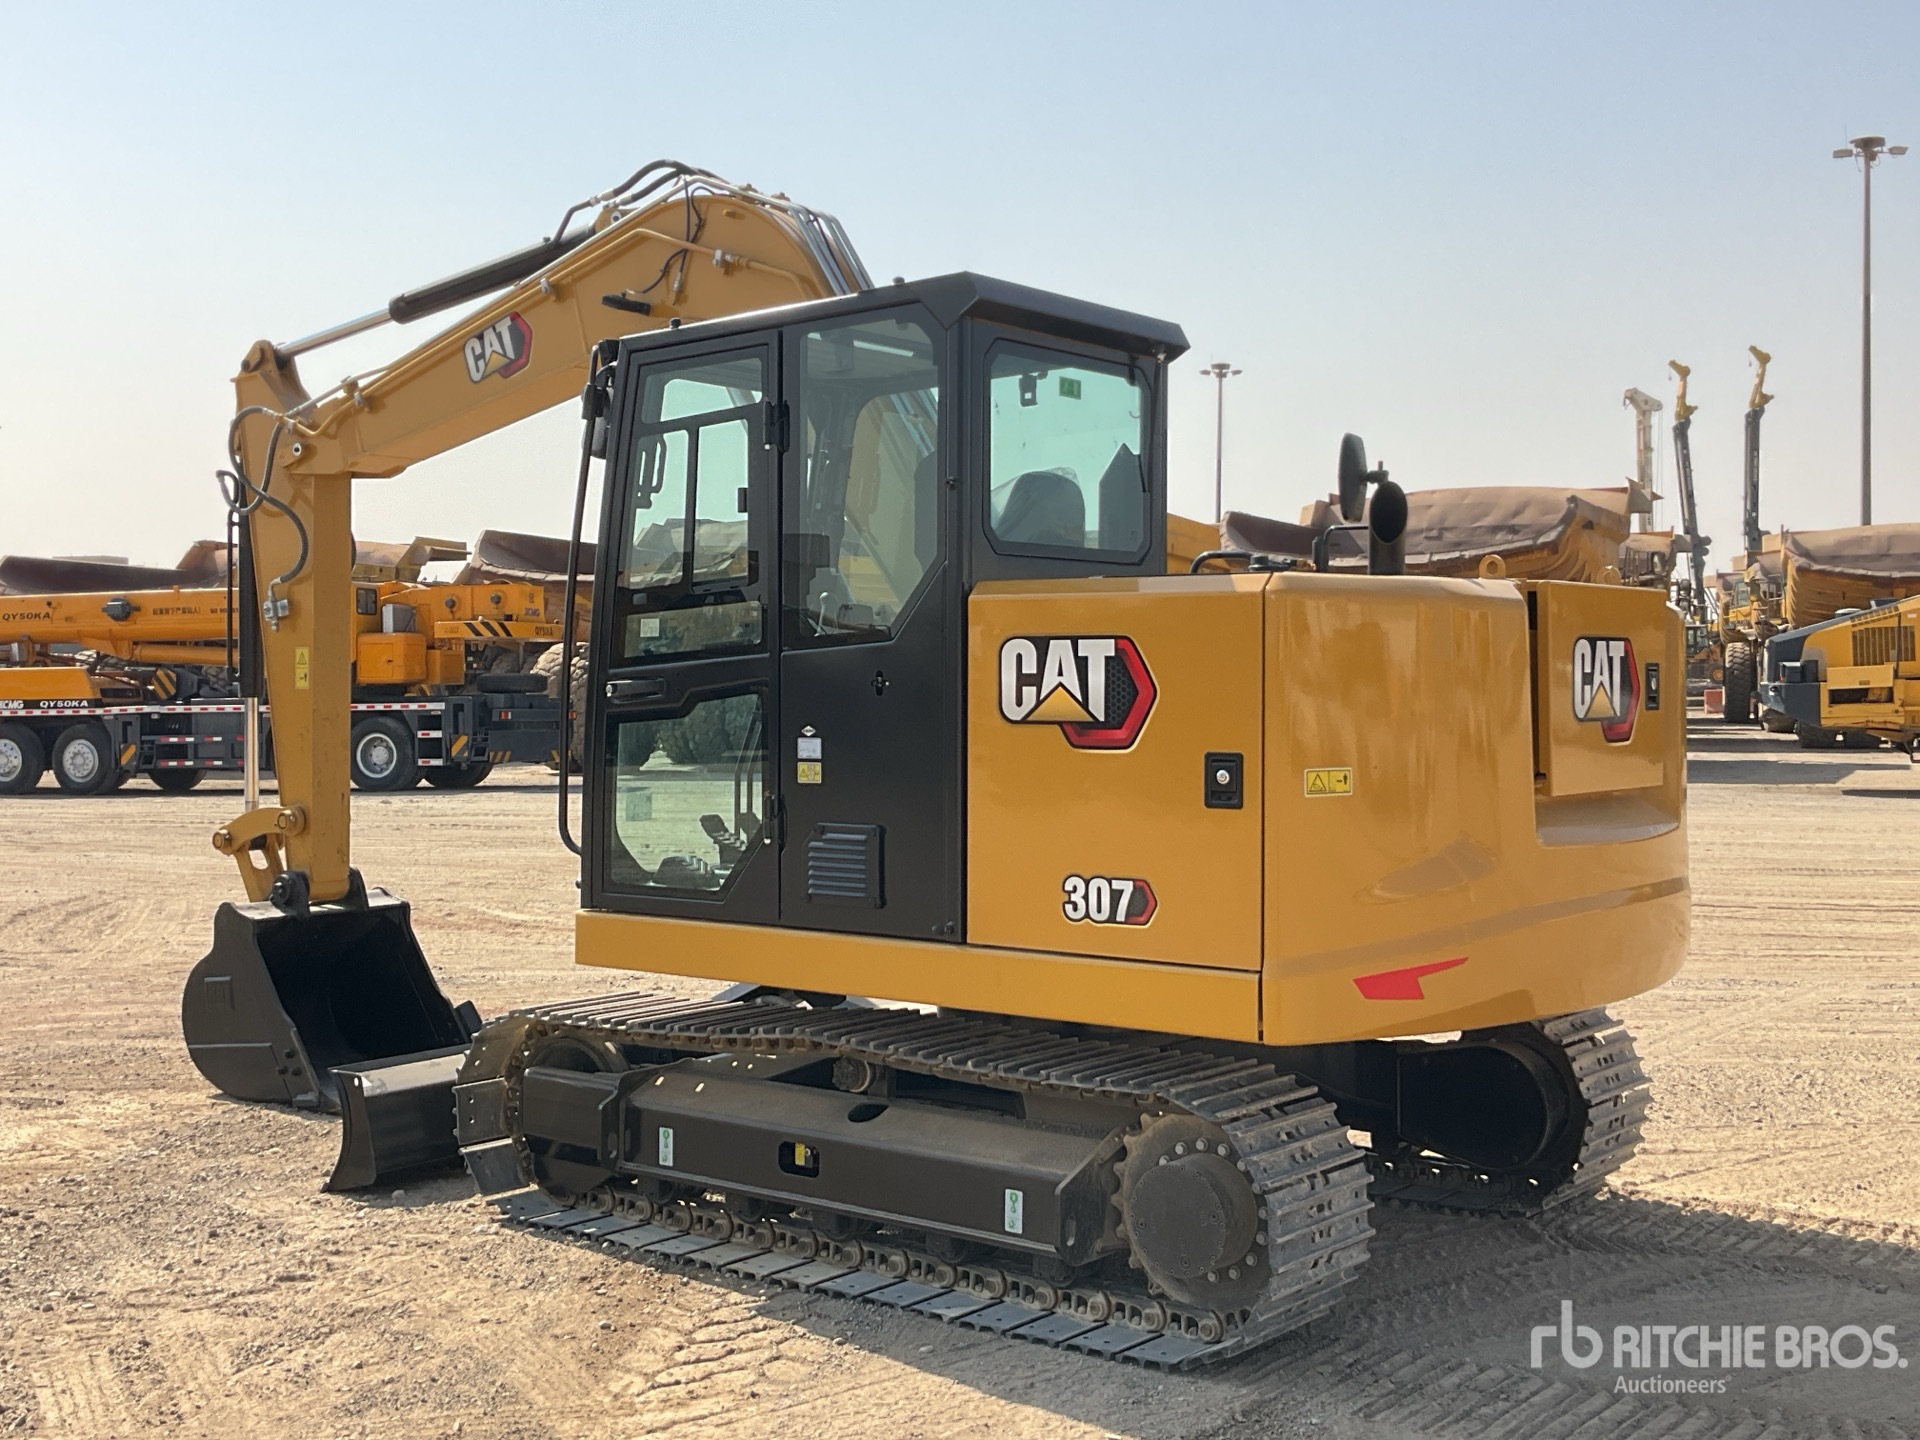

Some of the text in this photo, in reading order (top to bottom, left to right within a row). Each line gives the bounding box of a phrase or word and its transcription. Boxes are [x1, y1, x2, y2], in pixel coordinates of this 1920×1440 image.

[464, 315, 515, 382] CAT
[2, 612, 51, 621] QY50KA
[40, 700, 88, 708] QY50KA
[1001, 638, 1116, 722] CAT
[1574, 638, 1625, 719] CAT
[1064, 876, 1134, 922] 307
